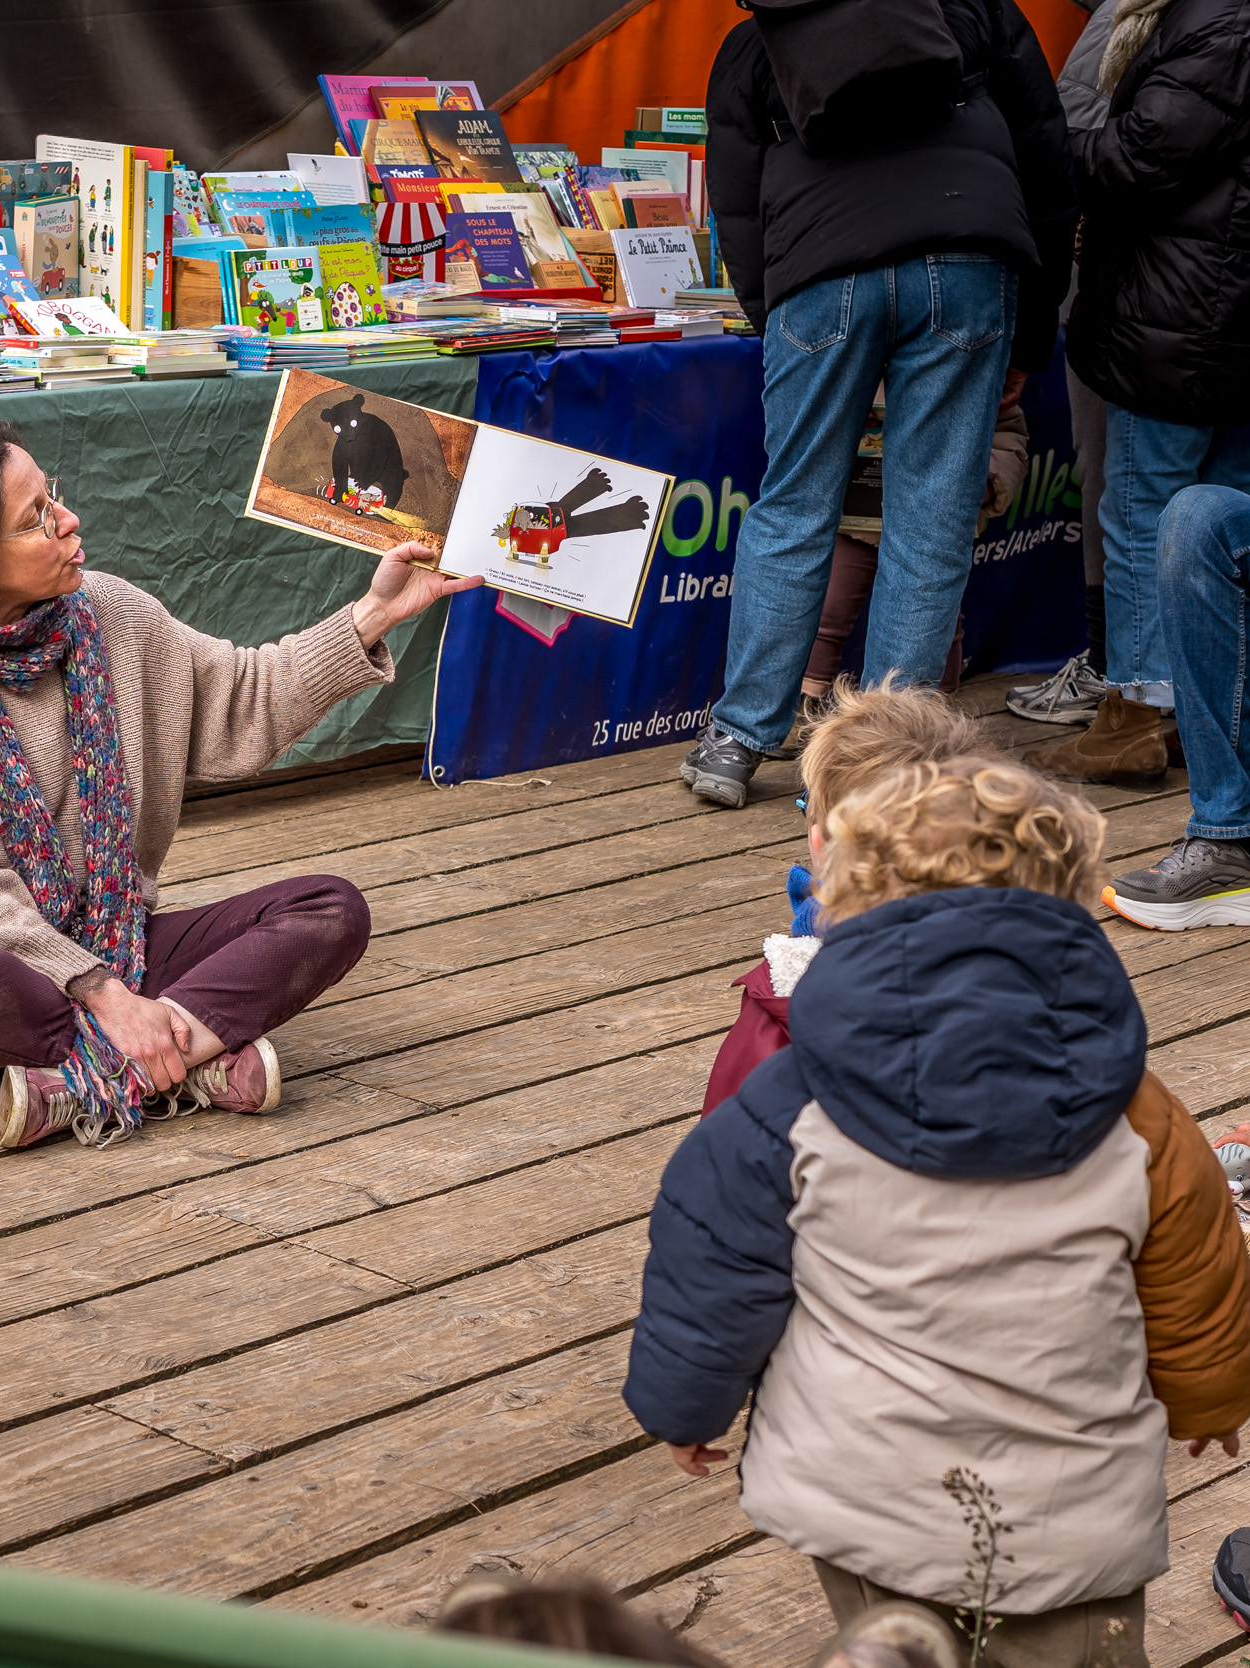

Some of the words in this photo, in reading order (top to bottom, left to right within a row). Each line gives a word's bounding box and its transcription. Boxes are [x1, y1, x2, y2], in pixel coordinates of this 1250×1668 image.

[339, 99, 352, 112] du
[669, 112, 681, 120] Les
[458, 120, 493, 134] ADAM
[397, 183, 439, 192] Monsieur
[244, 200, 271, 208] CHÂTEAU
[652, 212, 668, 221] Beau
[488, 218, 496, 226] LE
[56, 224, 72, 234] DOUCES
[320, 227, 333, 237] plus
[334, 227, 349, 236] gros
[473, 228, 513, 236] CHAPITEAU
[337, 236, 366, 245] Pâques
[390, 245, 407, 254] main
[408, 243, 422, 255] petit
[423, 239, 443, 252] pouce
[628, 240, 638, 255] Le
[638, 239, 658, 254] Petit
[658, 238, 687, 253] Prince
[282, 258, 312, 269] LOUP
[592, 720, 610, 746] 25
[614, 721, 642, 743] rue
[645, 711, 672, 736] des
